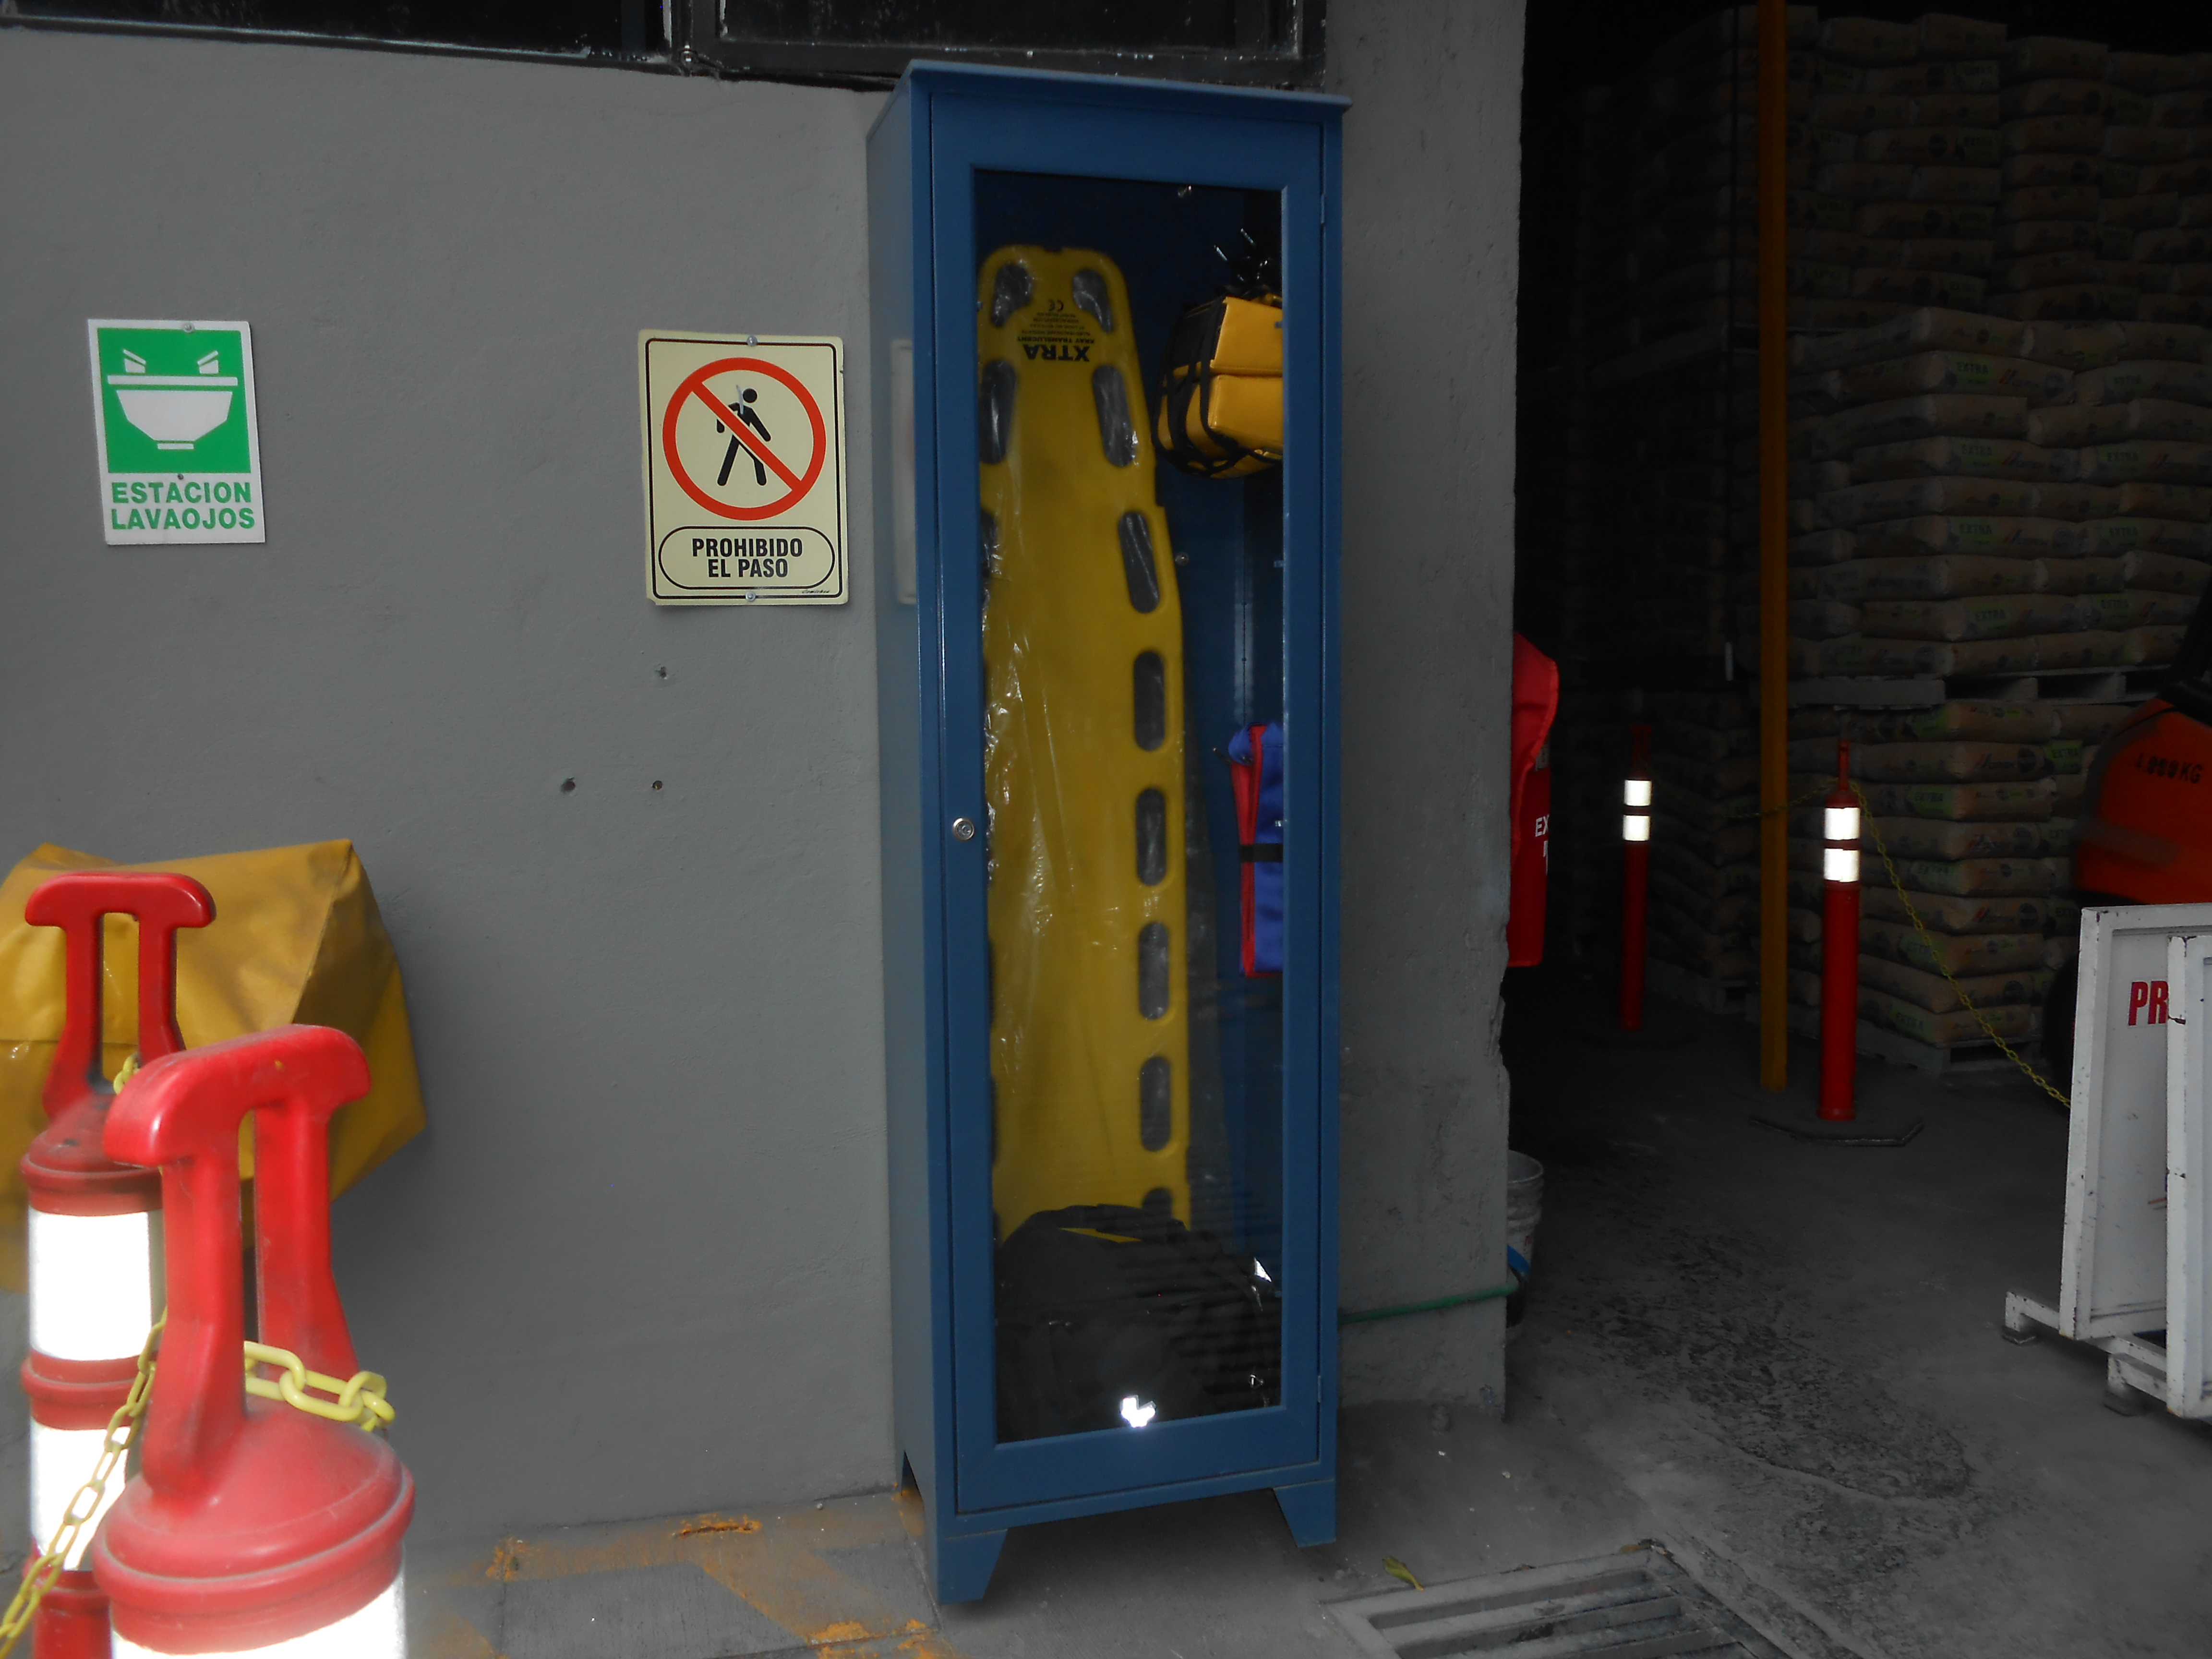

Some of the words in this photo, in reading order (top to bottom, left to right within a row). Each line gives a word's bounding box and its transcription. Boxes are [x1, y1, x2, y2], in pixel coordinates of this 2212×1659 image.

[1023, 344, 1091, 362] XTRA
[111, 481, 252, 504] ESTACION
[111, 507, 255, 530] LAVAOJOS
[692, 538, 803, 557] PROHIBIDO
[708, 558, 731, 578] EL
[738, 558, 789, 578] PASO
[2128, 980, 2169, 1026] PR
